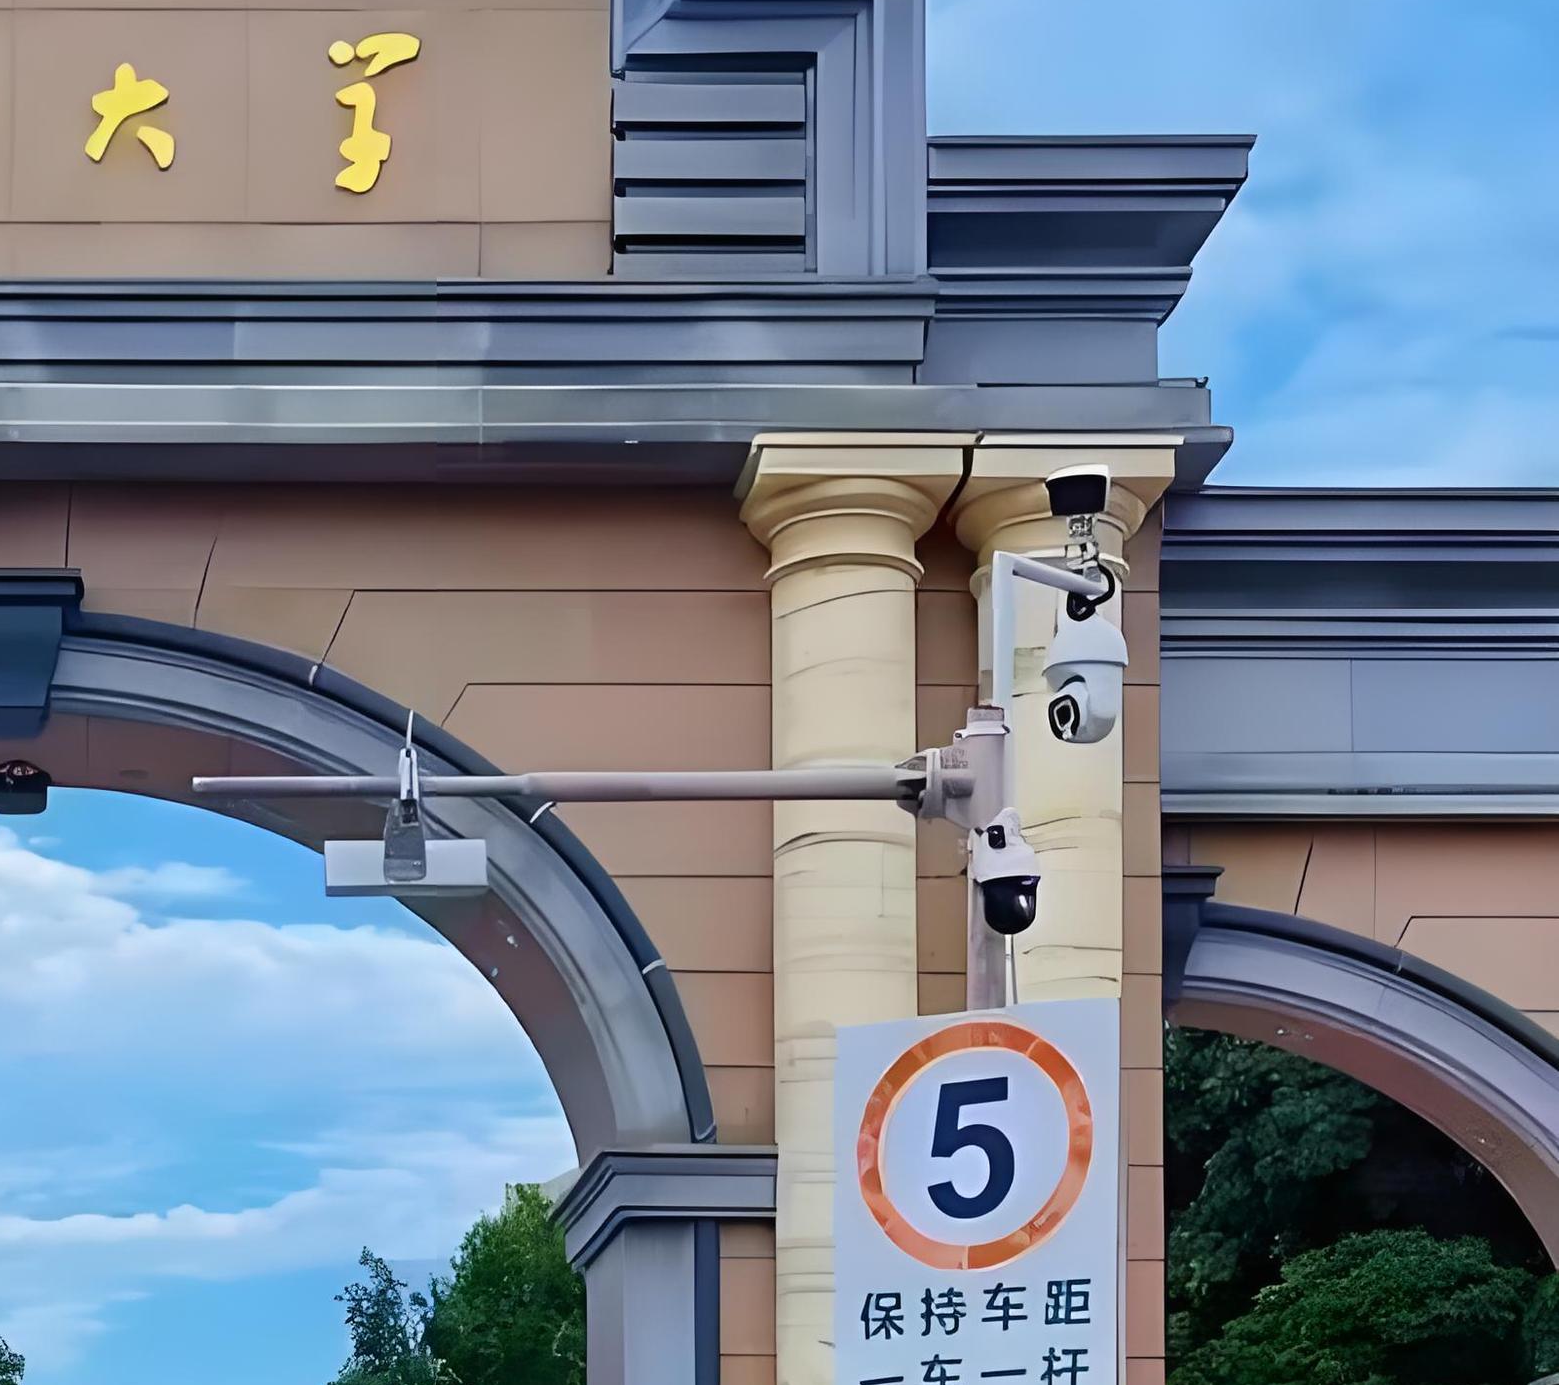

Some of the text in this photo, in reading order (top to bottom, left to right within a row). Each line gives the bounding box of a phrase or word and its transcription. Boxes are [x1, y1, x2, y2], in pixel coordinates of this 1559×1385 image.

[927, 1076, 1015, 1219] 5
[860, 1278, 1092, 1340] 保持车距
